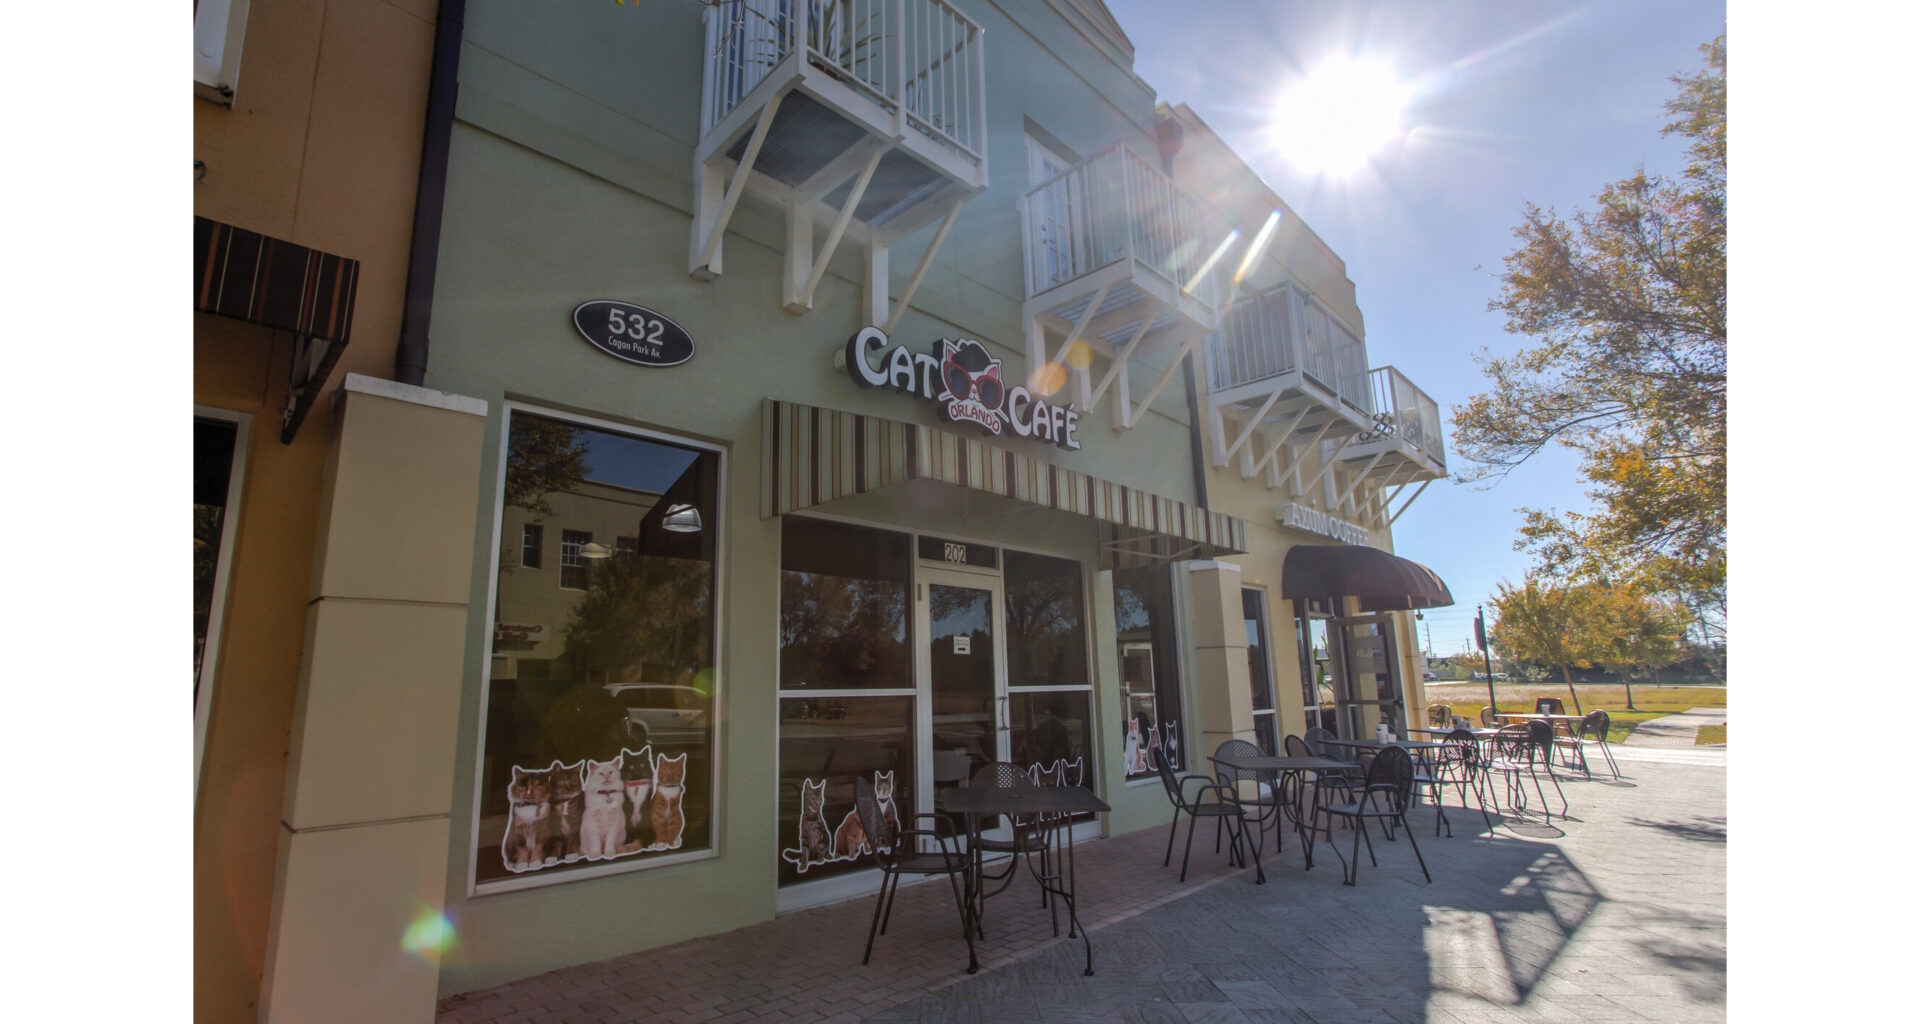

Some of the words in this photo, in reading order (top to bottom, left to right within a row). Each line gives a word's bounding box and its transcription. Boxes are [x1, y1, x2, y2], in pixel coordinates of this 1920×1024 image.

[608, 308, 664, 346] 532
[608, 336, 631, 350] Cagan
[633, 343, 649, 355] Park
[855, 326, 938, 399] CAT
[1008, 386, 1080, 449] CAFÉ
[950, 404, 1000, 433] ORLANDO
[1291, 503, 1328, 536] AXUM
[1329, 517, 1369, 546] COFFEE
[945, 545, 965, 564] 202
